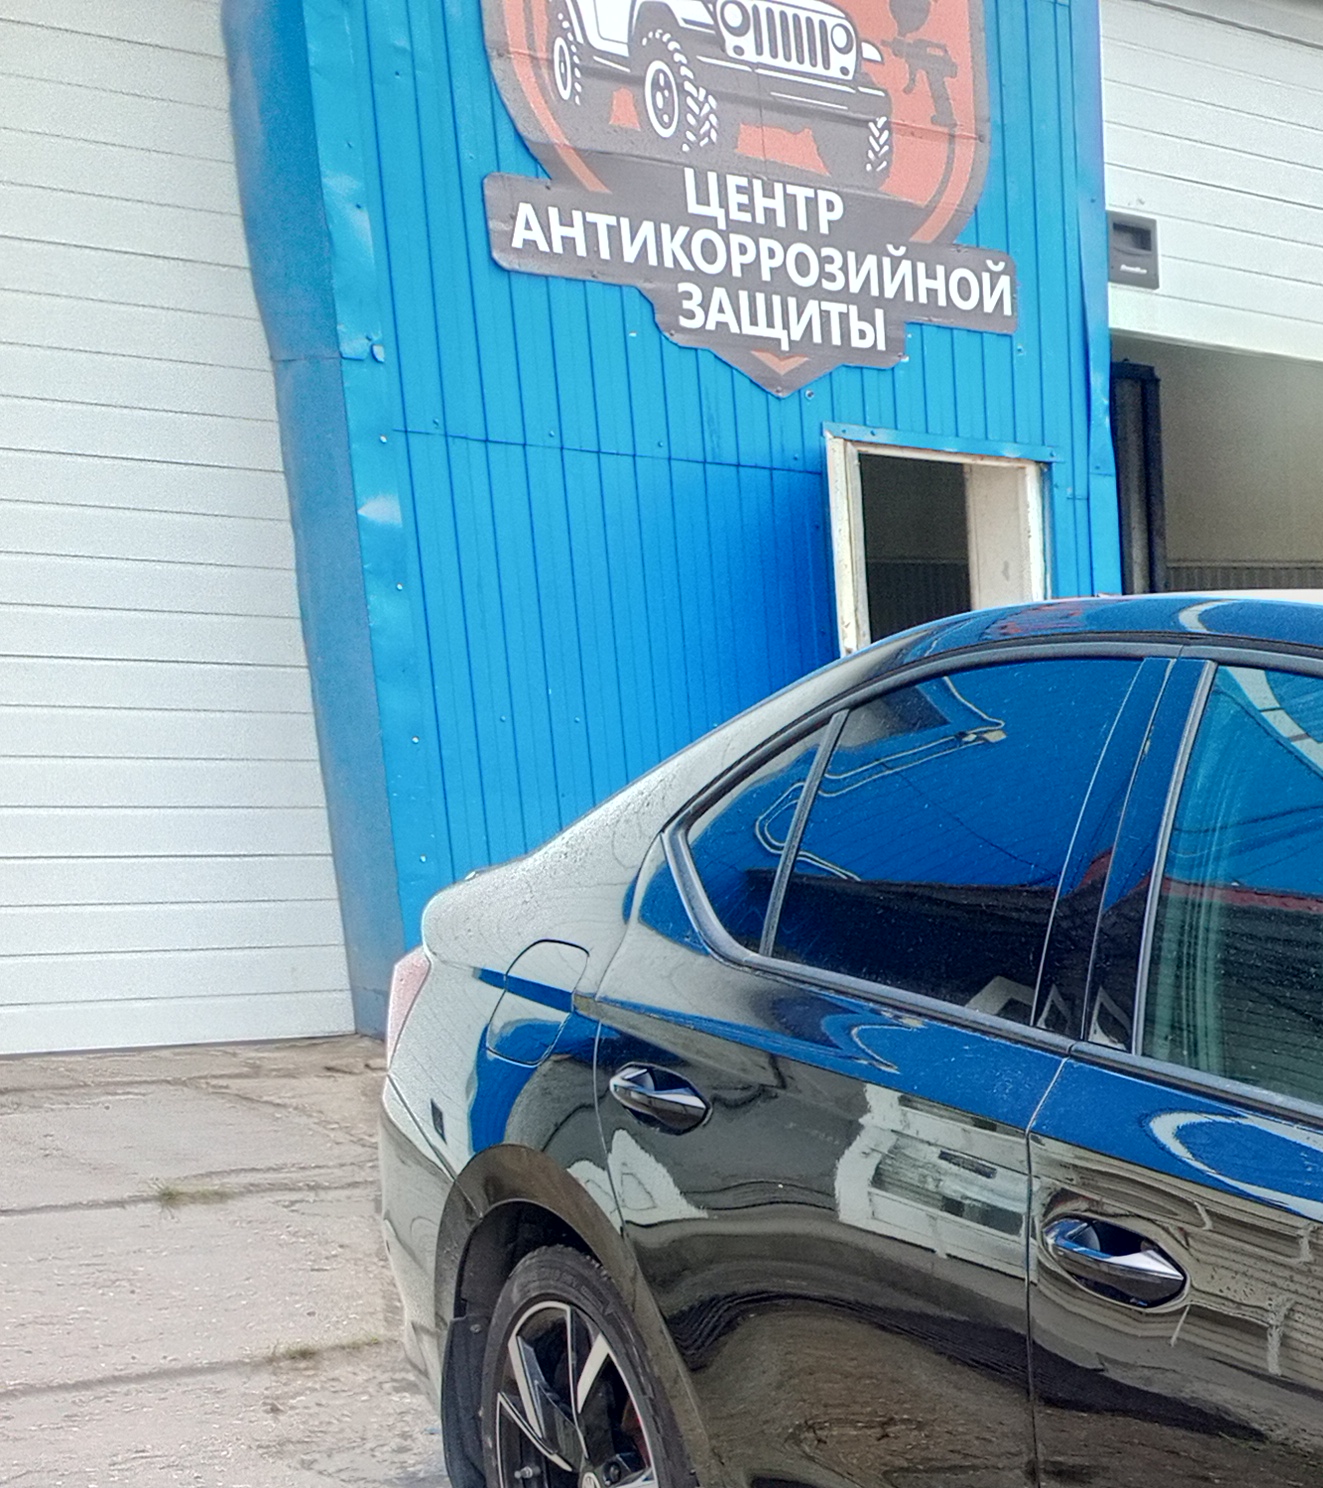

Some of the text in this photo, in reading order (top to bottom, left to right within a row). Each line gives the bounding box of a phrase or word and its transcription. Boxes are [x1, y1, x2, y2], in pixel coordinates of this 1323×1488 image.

[682, 167, 845, 236] ЦЕНТР
[510, 202, 1013, 317] АНТИКОРРОЗИЙНОЙ
[677, 282, 886, 352] ЗАЩИТЫ
